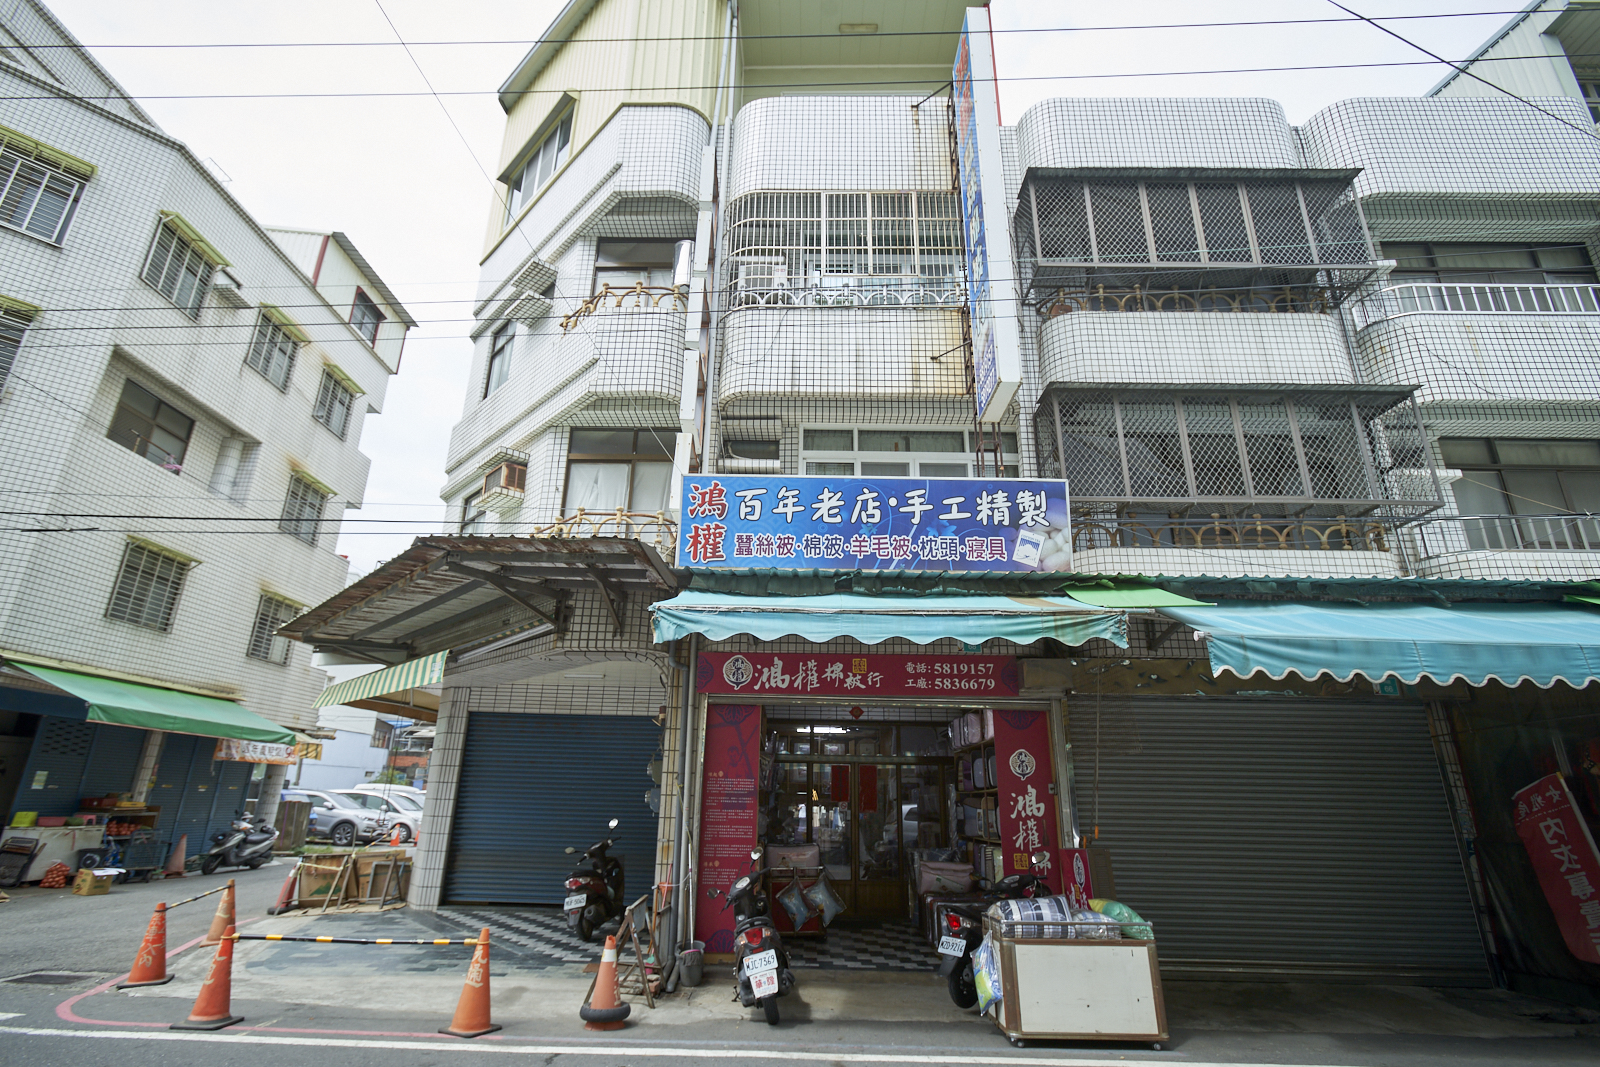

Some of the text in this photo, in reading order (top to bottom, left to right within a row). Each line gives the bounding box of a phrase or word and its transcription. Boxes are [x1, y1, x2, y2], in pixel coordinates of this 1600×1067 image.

[735, 486, 1050, 528] 百年老店·手工精製
[686, 481, 728, 563] 鴻權
[934, 663, 994, 675] 5819157
[934, 678, 995, 690] 5836679
